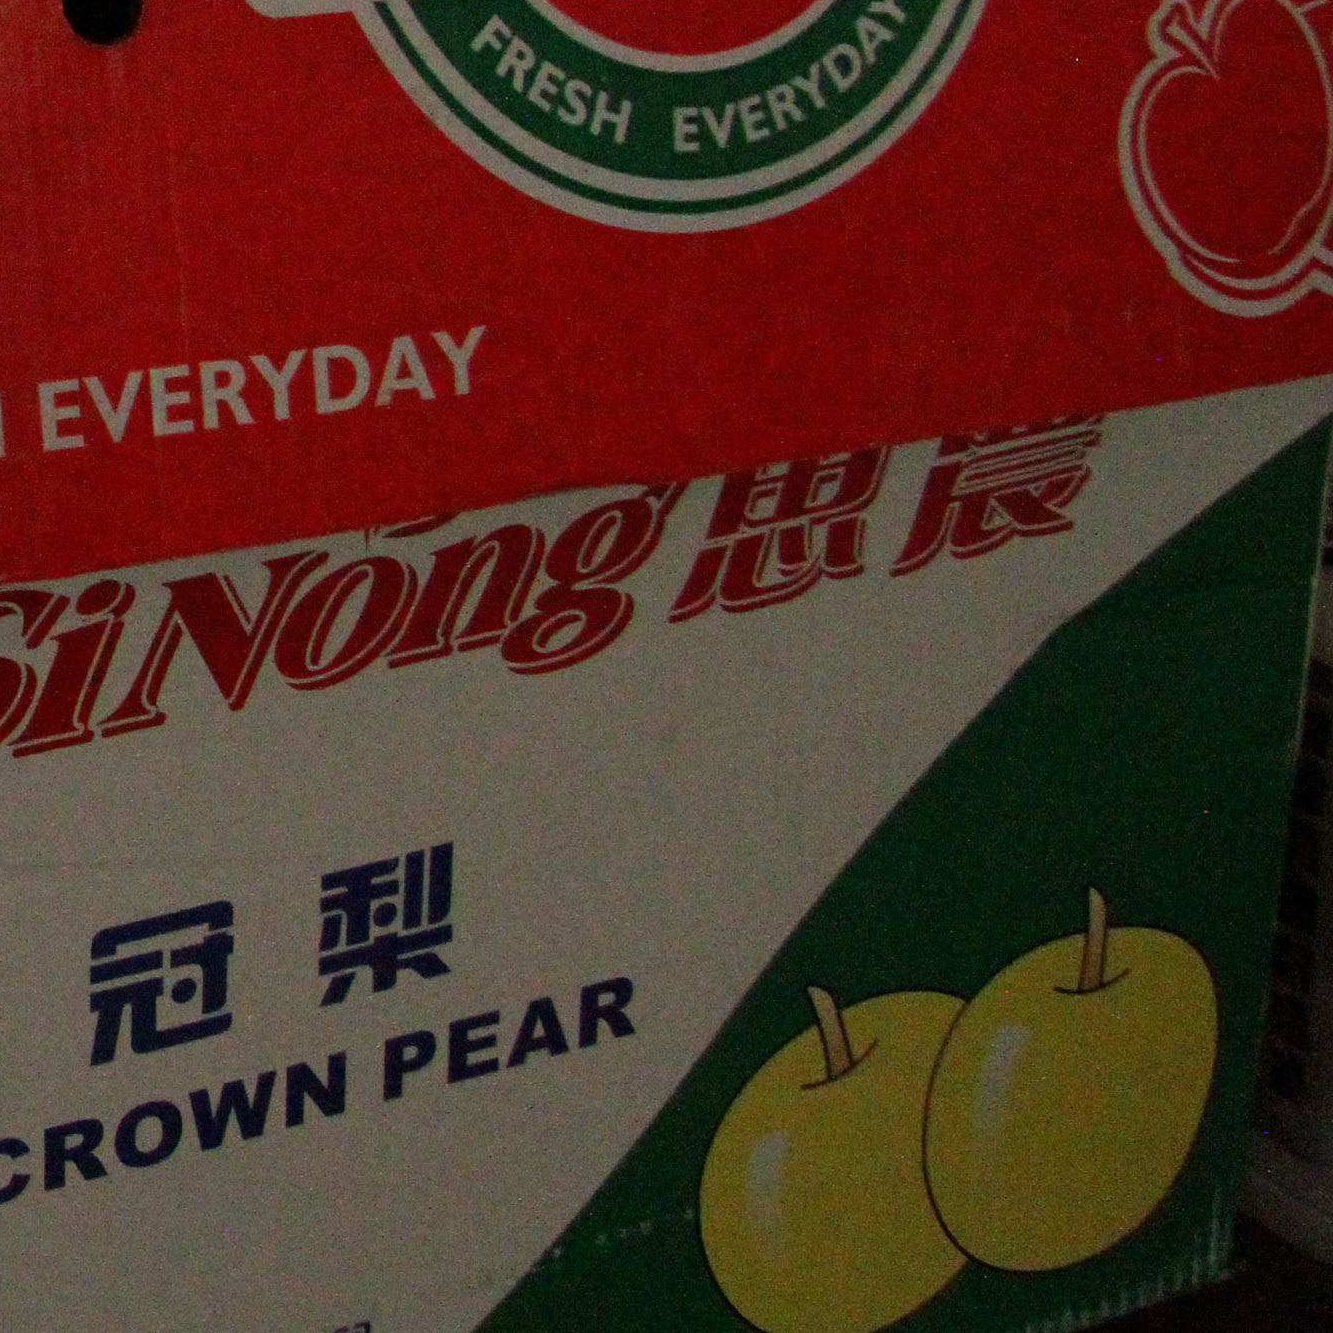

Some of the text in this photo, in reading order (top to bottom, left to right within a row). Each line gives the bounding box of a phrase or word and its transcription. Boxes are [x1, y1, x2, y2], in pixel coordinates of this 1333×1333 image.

[471, 12, 632, 146] FRESH
[36, 325, 488, 453] EVERYDAY
[383, 975, 637, 1101] PEAR
